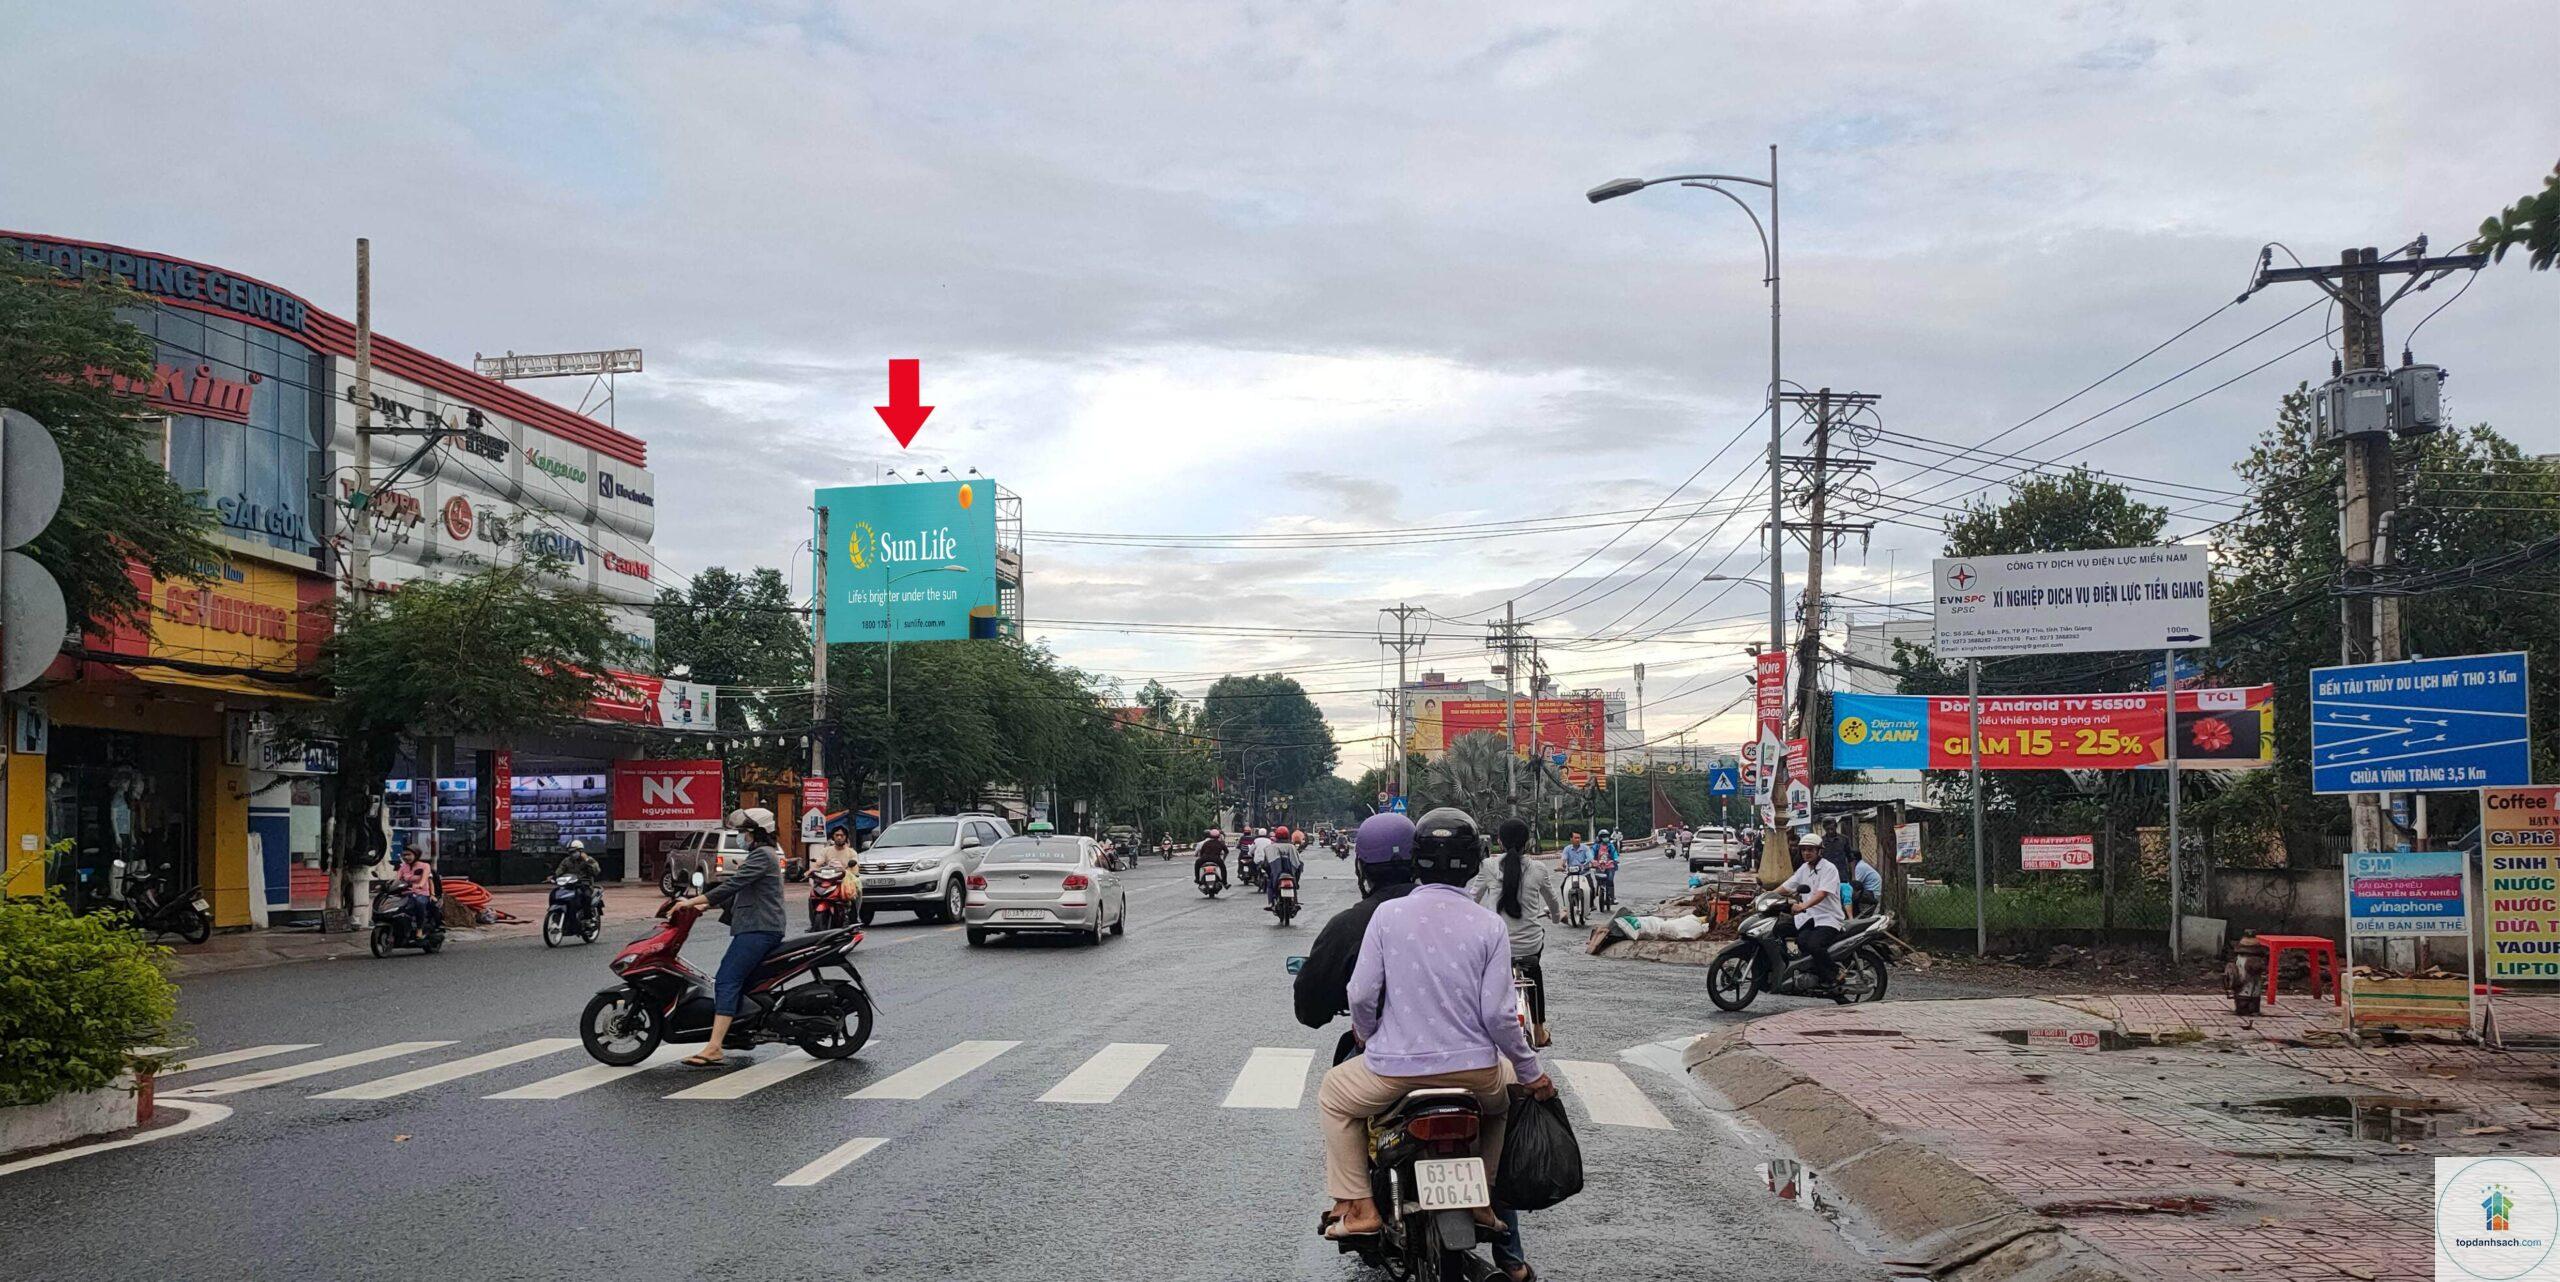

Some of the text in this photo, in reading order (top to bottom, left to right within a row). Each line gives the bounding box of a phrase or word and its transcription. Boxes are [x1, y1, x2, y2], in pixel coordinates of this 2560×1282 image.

[6, 240, 307, 333] HOPPING CENTER
[880, 527, 957, 563] Sun Life
[2006, 560, 2034, 571] CÔNG
[2036, 561, 2048, 570] TY
[2051, 559, 2074, 570] DỊCH
[2166, 553, 2188, 562] NAM
[848, 587, 958, 607] Life's brighter under the sun
[1993, 586, 2004, 608] XÍ
[2006, 585, 2044, 611] NGHIỆP
[2048, 587, 2073, 609] DỊCH
[2076, 585, 2090, 608] VỤ
[2093, 581, 2118, 607] ĐIỆN
[2121, 581, 2141, 606] LỰC
[2171, 580, 2204, 599] GIANG
[904, 619, 946, 629] sunlife.com.vn
[2319, 670, 2517, 696] BẾN TÀU THỦY DU LỊCH MỸ THO 3 Km
[1989, 700, 2060, 712] Android
[2063, 699, 2087, 711] TV
[2091, 697, 2147, 711] S6500
[2204, 692, 2239, 702] TCL
[1898, 719, 1919, 731] máy
[2093, 715, 2111, 724] nói
[1869, 729, 1920, 743] XANH
[2016, 729, 2053, 756] 15
[2074, 729, 2144, 756] 25%
[2350, 765, 2487, 784] CHÙA VĨNH TRÀNG 3,5 Km
[642, 776, 695, 804] NK
[2487, 794, 2547, 810] Coffee
[2529, 816, 2550, 827] HẠT
[2490, 831, 2555, 845] Cà Phê
[2493, 857, 2547, 870] SINH
[2494, 875, 2556, 891] NƯỚC
[2376, 901, 2444, 914] vinaphone
[2494, 896, 2557, 912] NƯỚC
[2356, 917, 2385, 930] ĐIỂM
[2415, 921, 2436, 930] SIM
[2495, 917, 2540, 933] DỪA
[1426, 1163, 1474, 1184] 63-C1
[1424, 1183, 1484, 1206] 206.41
